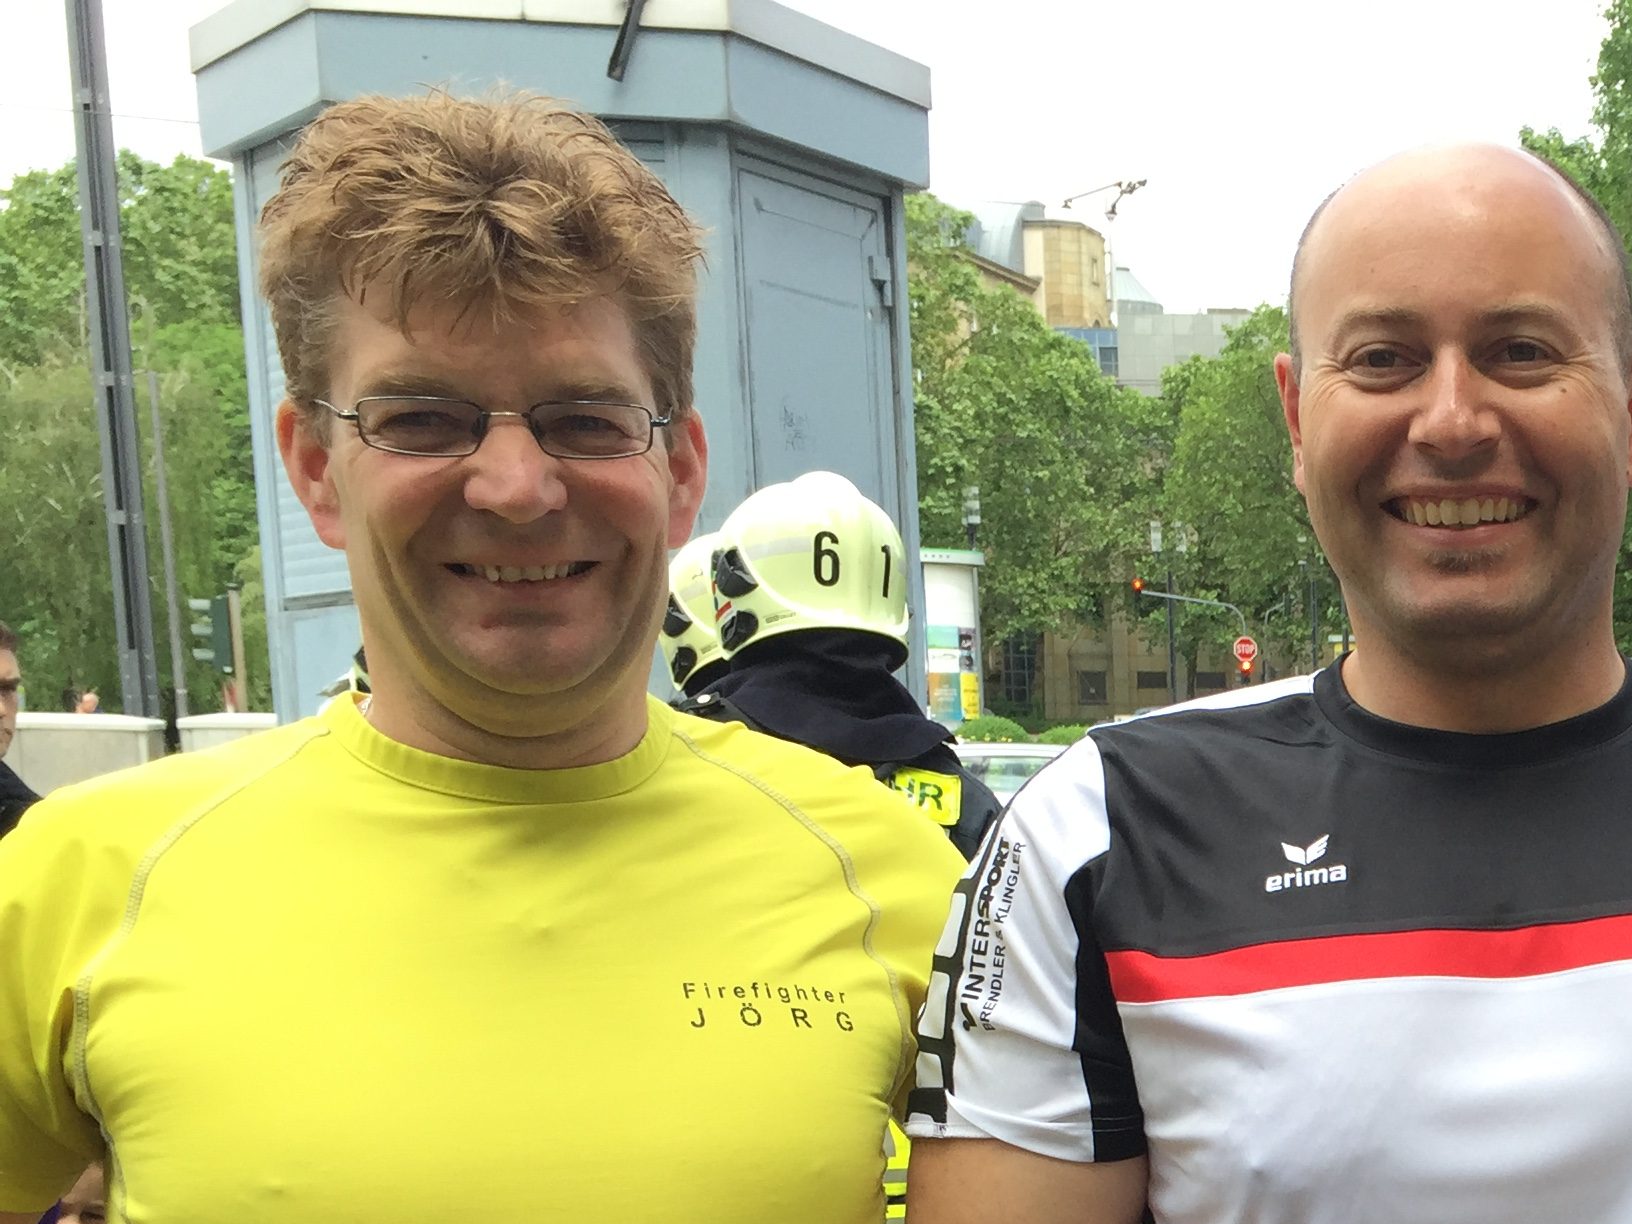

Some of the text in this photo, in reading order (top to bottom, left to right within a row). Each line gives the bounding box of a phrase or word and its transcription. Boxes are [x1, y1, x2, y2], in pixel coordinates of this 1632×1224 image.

[1236, 643, 1255, 654] STOP
[1265, 864, 1347, 893] erima
[961, 837, 1010, 1000] INTERSPORT
[979, 945, 1006, 1031] BRENDLER
[993, 841, 1026, 924] KLINGLER
[683, 982, 845, 1003] Firefighter
[690, 1002, 854, 1032] JÖRG
